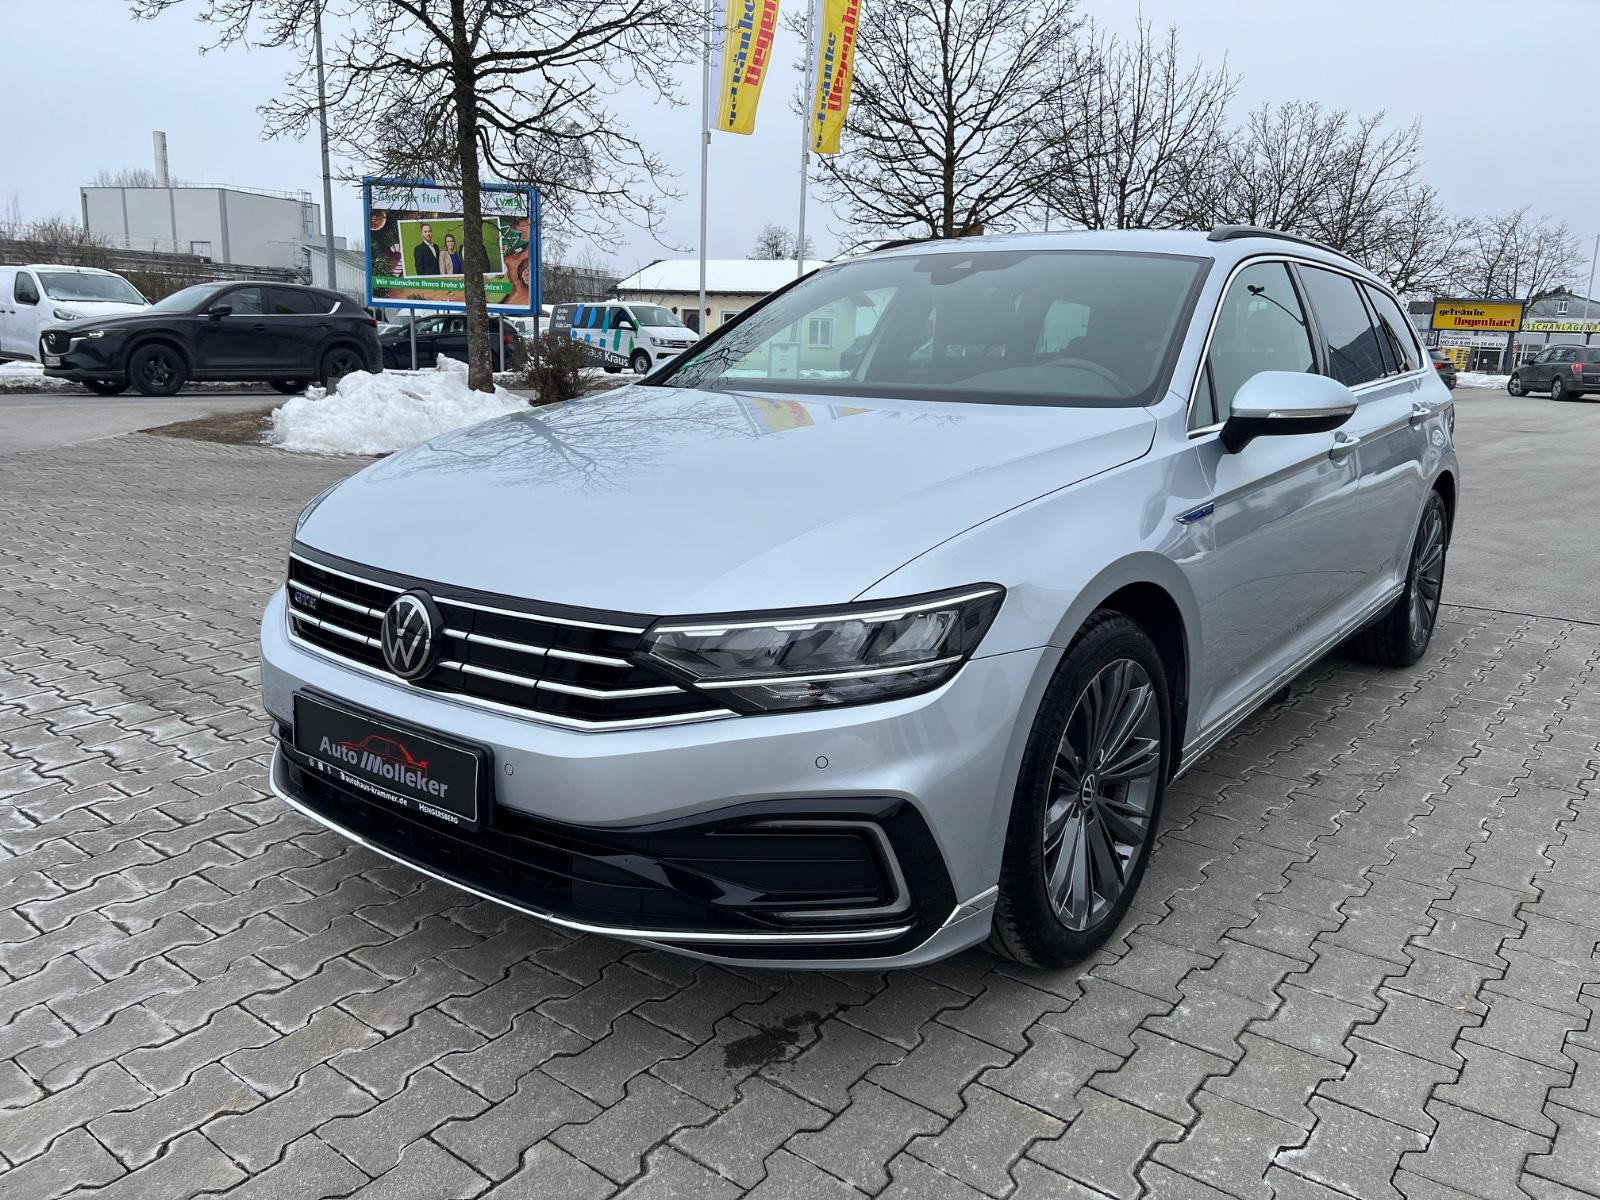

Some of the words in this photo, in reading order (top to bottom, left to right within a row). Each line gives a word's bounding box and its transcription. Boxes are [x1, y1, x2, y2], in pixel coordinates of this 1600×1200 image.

[389, 278, 420, 287] wünschen
[421, 280, 439, 288] Ihnen
[441, 281, 457, 289] frohe
[1439, 308, 1485, 316] getränke
[604, 351, 629, 367] Kraus
[319, 736, 358, 766] Auto
[345, 773, 408, 806] autohaus-krammer.de
